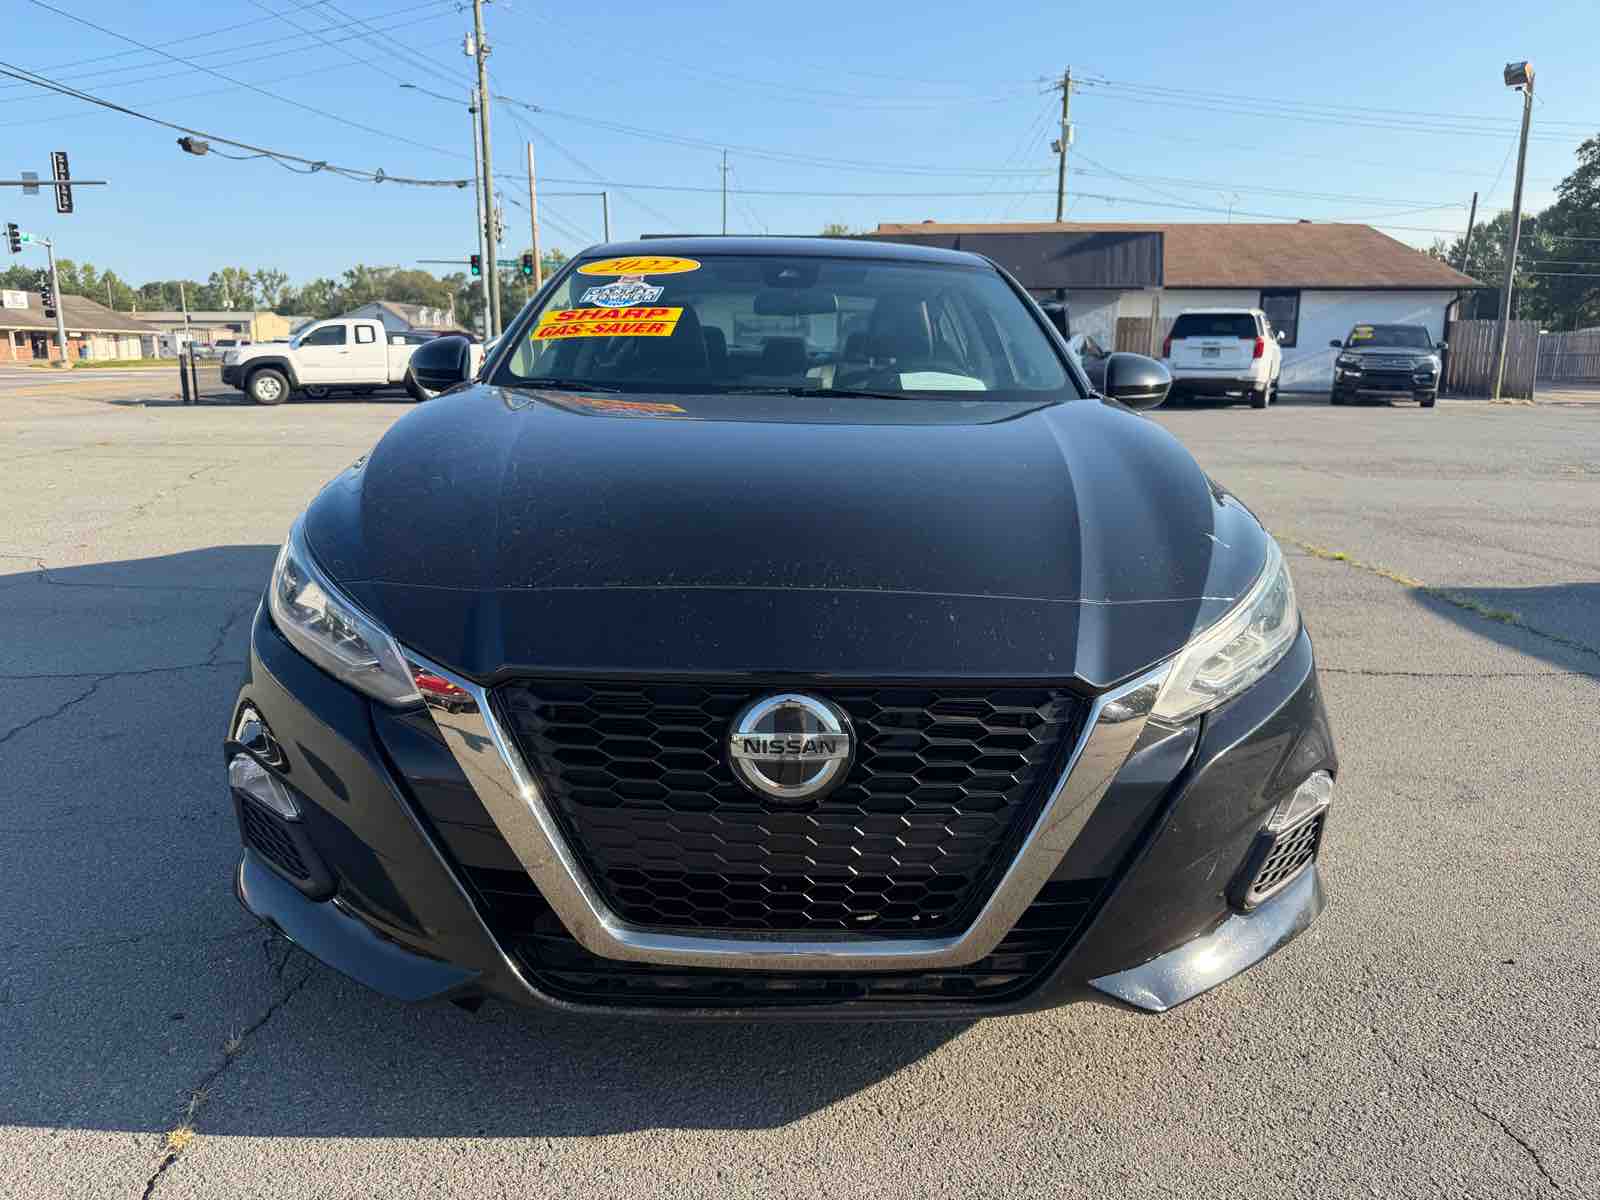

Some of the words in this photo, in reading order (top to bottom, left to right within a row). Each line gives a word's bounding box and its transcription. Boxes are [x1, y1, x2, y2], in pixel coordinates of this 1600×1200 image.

[597, 260, 681, 272] 2022
[554, 309, 668, 321] SHARP
[743, 739, 836, 754] NISSAN
